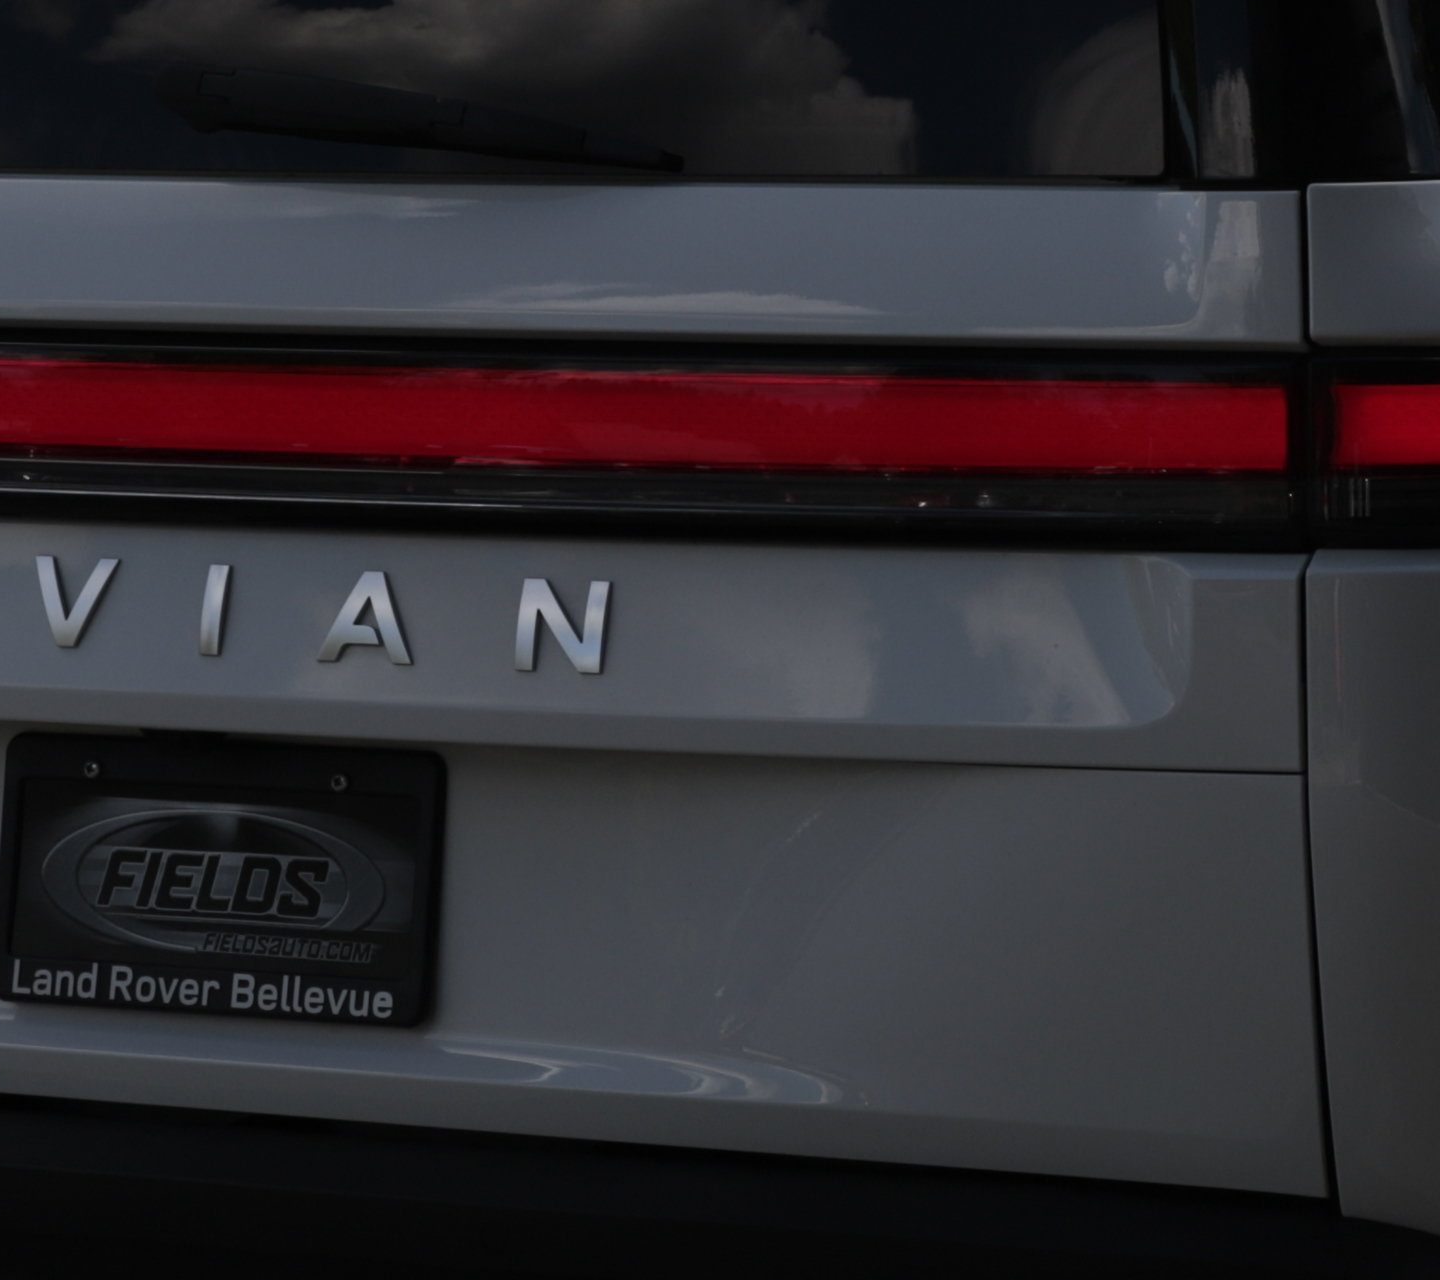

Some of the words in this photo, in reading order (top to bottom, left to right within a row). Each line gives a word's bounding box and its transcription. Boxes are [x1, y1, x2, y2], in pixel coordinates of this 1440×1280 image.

[96, 848, 330, 918] FIELDS
[11, 959, 100, 999] Land
[109, 965, 220, 1006] Rover
[230, 973, 394, 1019] Bellevue
